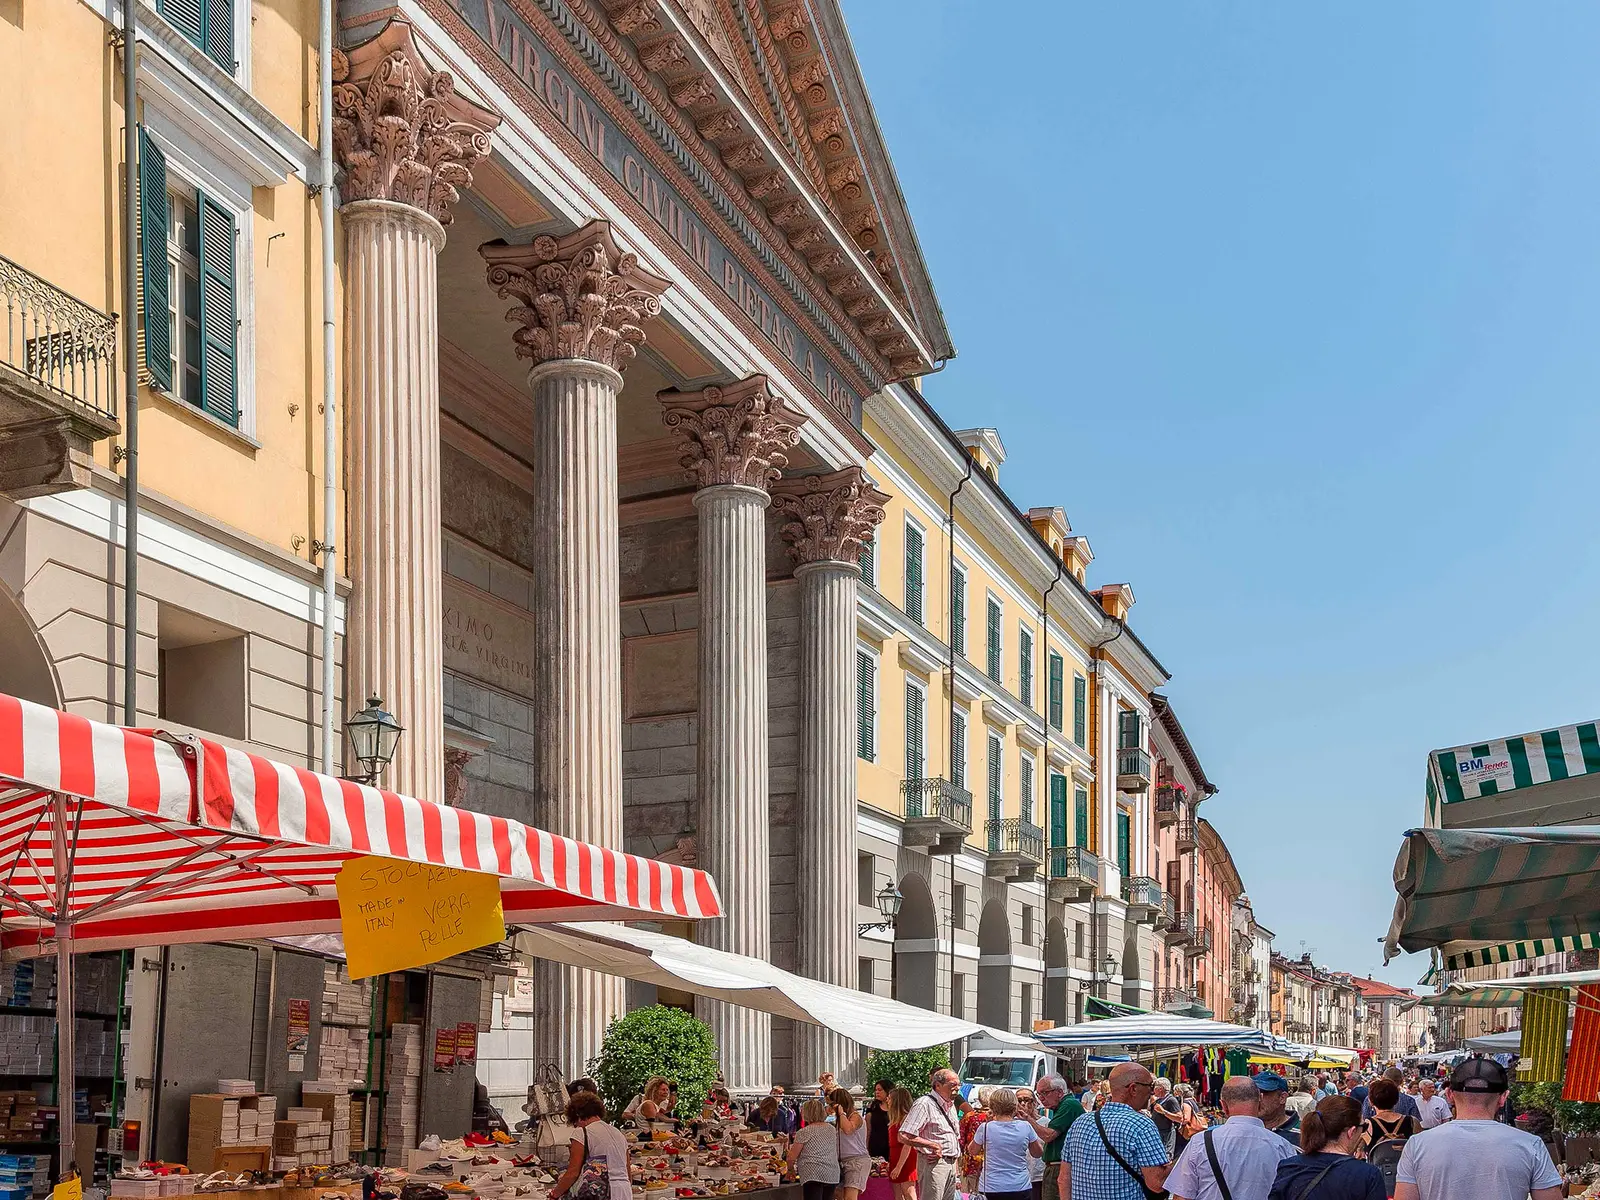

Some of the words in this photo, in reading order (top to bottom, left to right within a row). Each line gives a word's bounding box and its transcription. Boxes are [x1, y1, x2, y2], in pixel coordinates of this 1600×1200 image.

[486, 0, 605, 163] VIRGINI
[622, 154, 711, 271] CIVIUM
[722, 258, 795, 359] PIETAS
[803, 350, 816, 387] A
[1459, 758, 1484, 773] BM
[358, 897, 393, 914] MADE
[365, 912, 395, 932] ITALY
